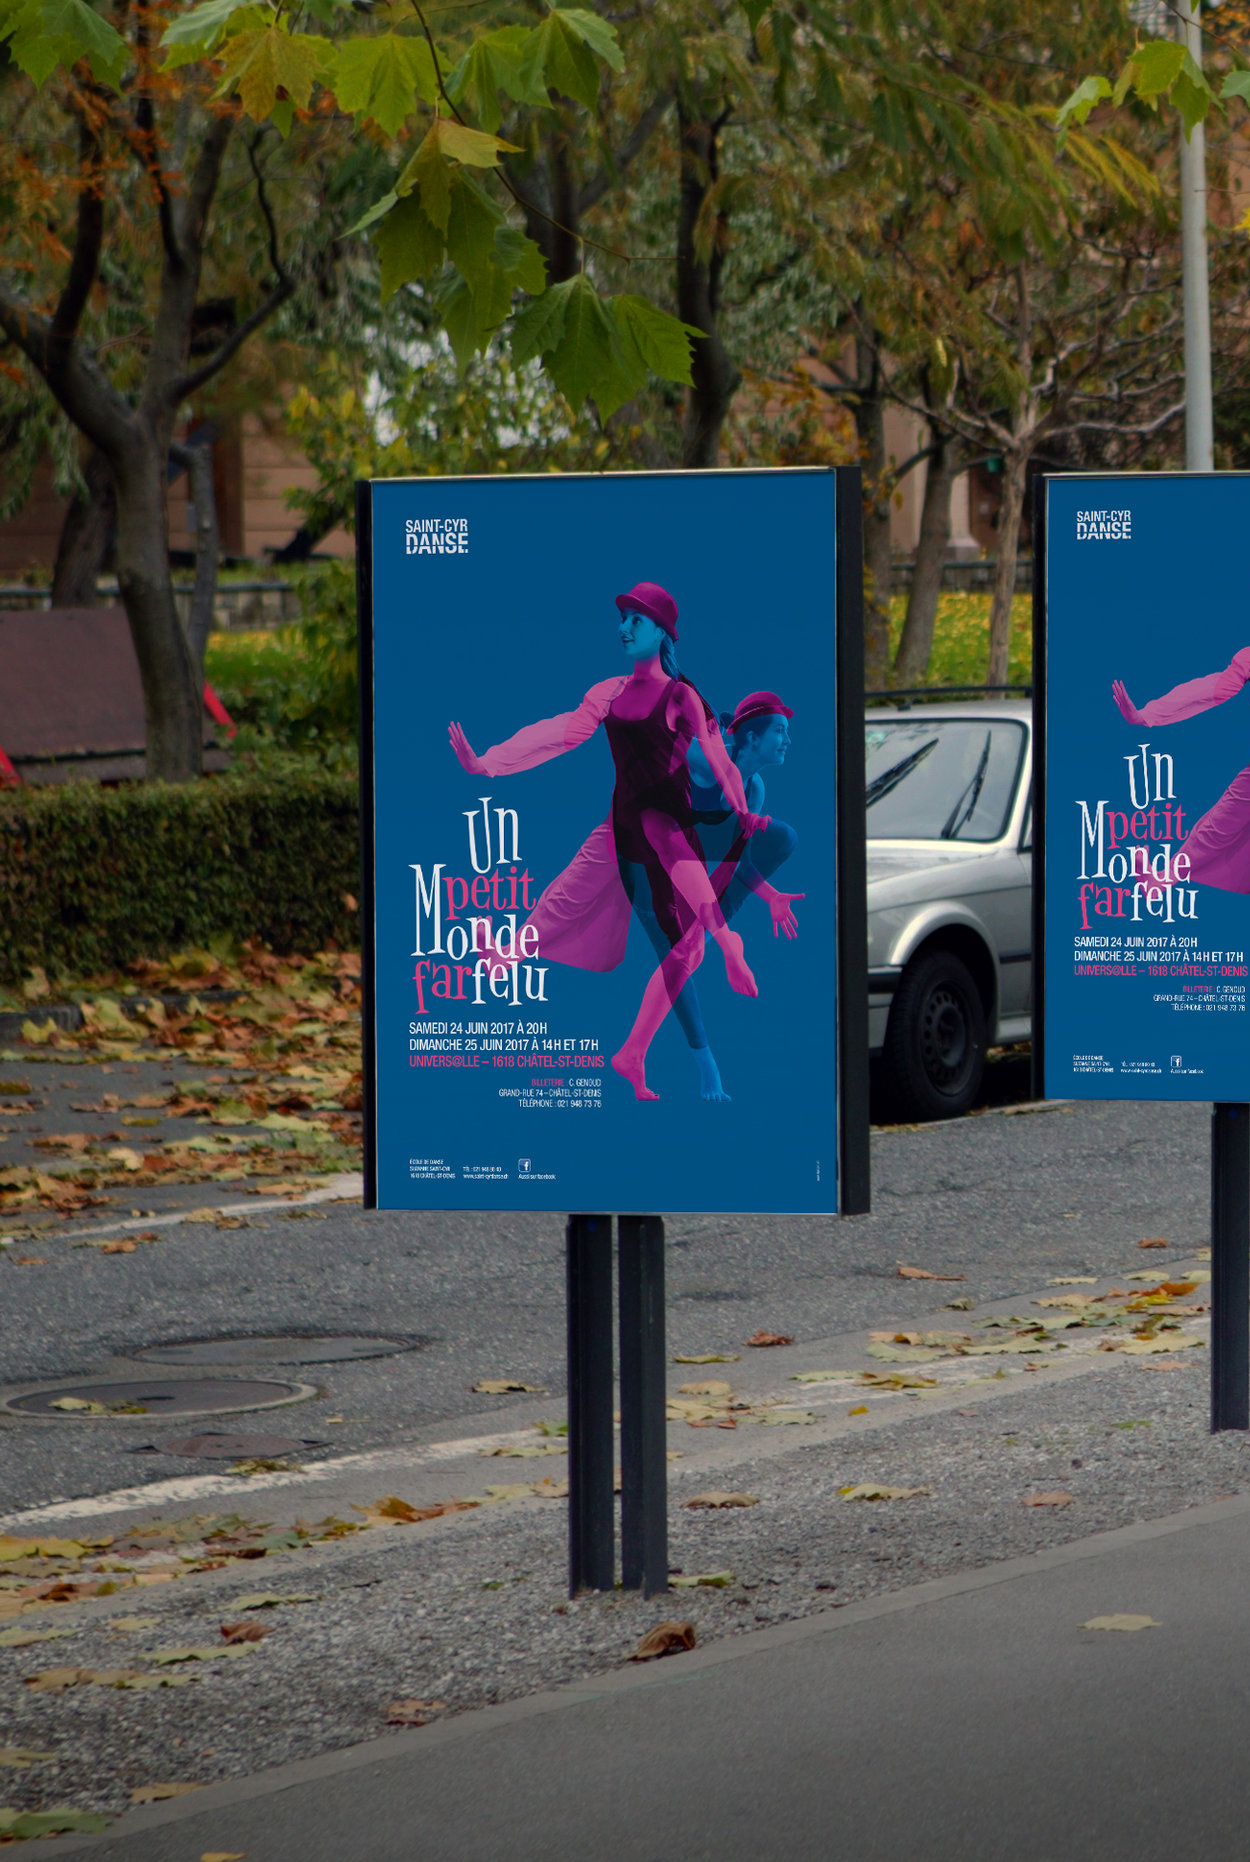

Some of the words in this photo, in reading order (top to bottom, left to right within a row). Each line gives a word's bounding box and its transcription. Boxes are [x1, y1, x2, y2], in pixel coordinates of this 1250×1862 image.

[1076, 510, 1131, 522] SAINT-CYR
[405, 518, 468, 533] SAINT-CYR
[1123, 743, 1177, 810] Un
[1105, 802, 1189, 850] petit
[461, 796, 523, 874] Un
[1075, 800, 1191, 884] Monde
[441, 866, 537, 921] petit
[408, 863, 540, 961] Monde
[1077, 880, 1199, 930] farfelu
[1074, 936, 1109, 947] SAMEDI
[1110, 936, 1122, 947] 24
[1124, 936, 1144, 947] JUIN
[1146, 936, 1168, 948] 2017
[1169, 934, 1177, 948] À
[1074, 951, 1122, 962] DIMANCHE
[1123, 951, 1135, 962] 25
[1136, 951, 1158, 962] JUIN
[1159, 951, 1181, 962] 2017
[1182, 949, 1190, 962] À
[1212, 952, 1223, 962] ET
[1074, 965, 1137, 976] UNIVERS@LLE
[1148, 965, 1168, 976] 1618
[1170, 963, 1248, 977] CHÂTEL-ST-DENIS
[412, 956, 550, 1015] farfelu
[409, 1022, 448, 1034] SAMEDI
[450, 1022, 463, 1034] 24
[465, 1022, 488, 1034] JUIN
[490, 1022, 514, 1034] 2017
[516, 1019, 525, 1034] À
[409, 1039, 463, 1051] DIMANCHE
[464, 1039, 478, 1051] 25
[479, 1039, 503, 1051] JUIN
[505, 1039, 529, 1051] 2017
[531, 1036, 539, 1051] À
[563, 1039, 577, 1051] ET
[409, 1055, 480, 1068] UNIVERS@LLE
[492, 1055, 515, 1068] 1618
[517, 1052, 605, 1068] CHÂTEL-ST-DENIS
[576, 1078, 602, 1087] GENOUD
[498, 1088, 535, 1097] GRAND-RUE
[536, 1088, 544, 1097] 74
[549, 1087, 602, 1098] CHÂTEL-ST-DENIS
[557, 1099, 569, 1108] 021
[584, 1099, 592, 1108] 73
